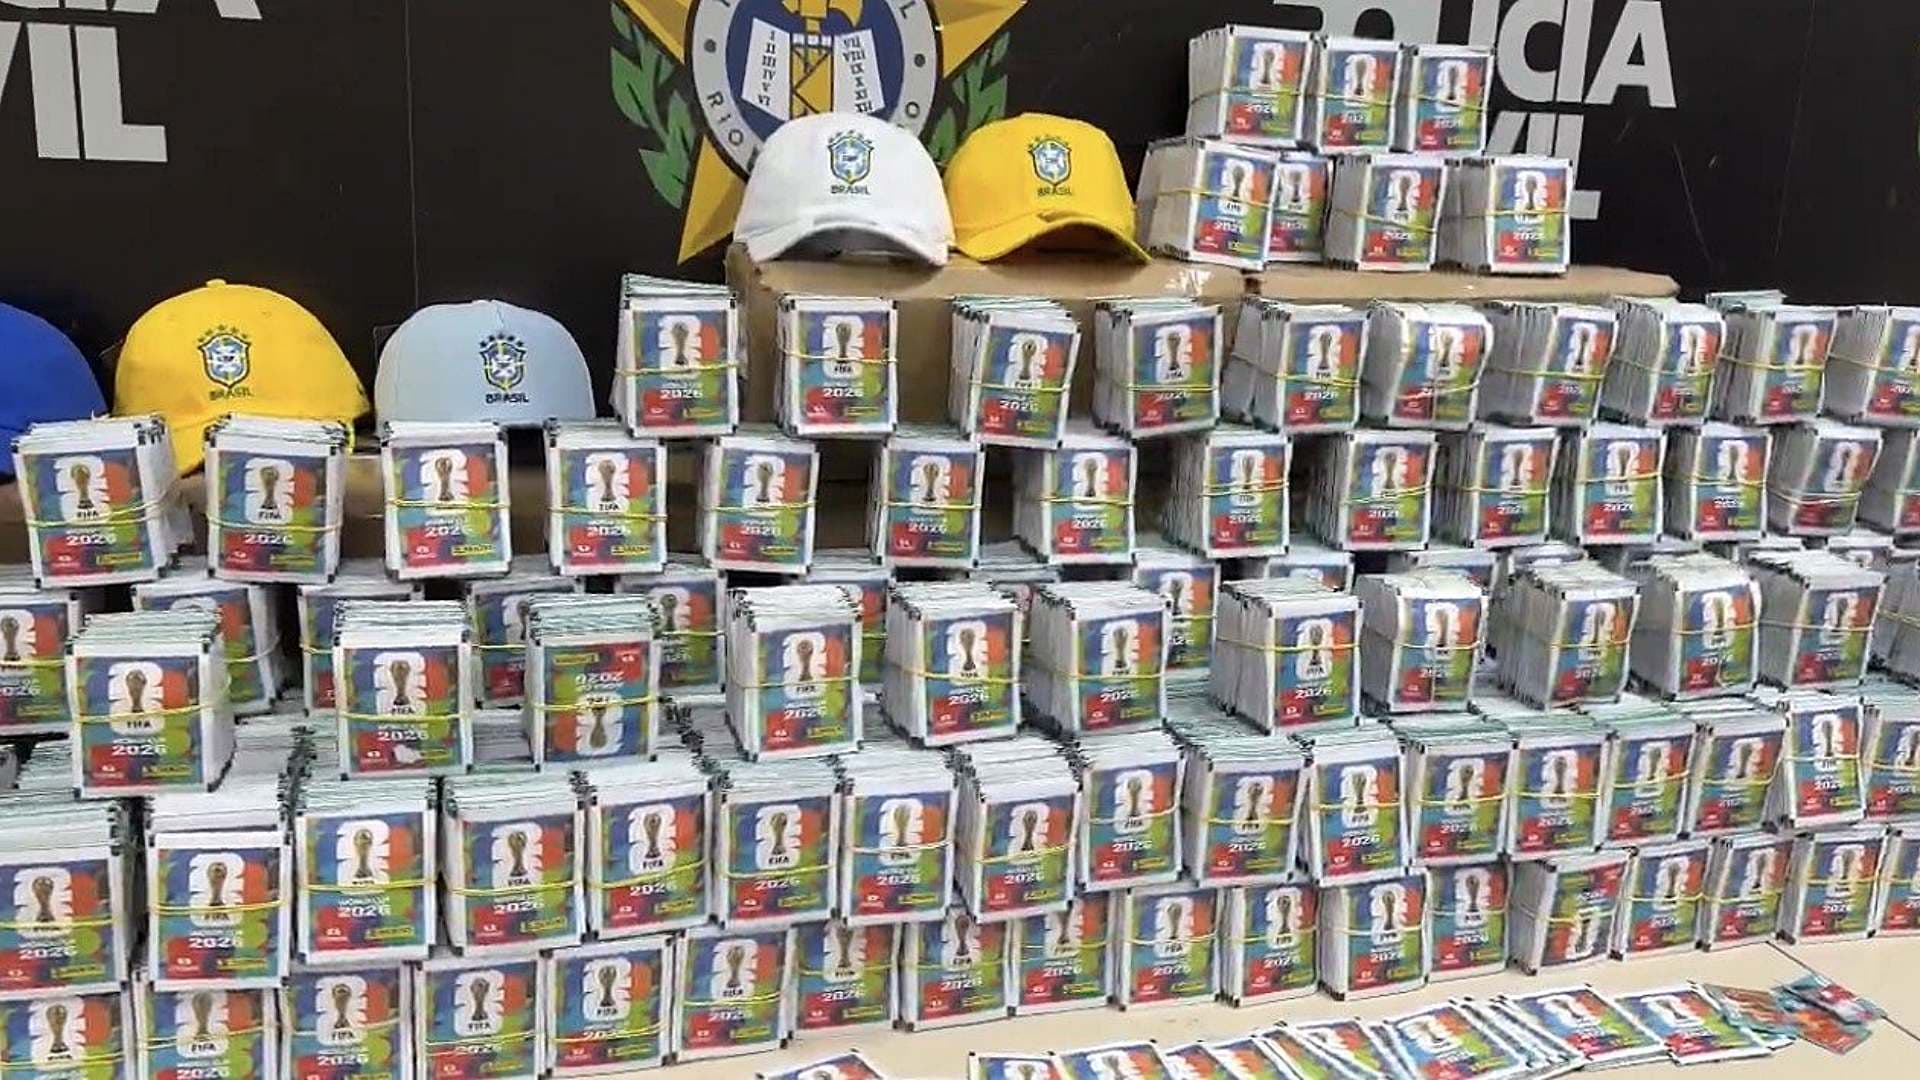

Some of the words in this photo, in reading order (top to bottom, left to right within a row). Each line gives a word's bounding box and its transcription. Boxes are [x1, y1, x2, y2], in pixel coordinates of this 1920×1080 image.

[830, 185, 871, 195] BRASIL
[660, 388, 704, 400] 2026
[823, 387, 864, 398] 2026
[484, 393, 529, 404] BRASIL
[76, 511, 98, 519] FIFA
[258, 511, 282, 519] FIFA
[244, 533, 293, 545] 2026
[0, 686, 41, 697] 026
[126, 720, 152, 729] FIFA
[377, 730, 430, 742] 2026
[112, 744, 168, 756] 2026
[1341, 834, 1380, 849] 2026
[643, 860, 664, 870] FIFA
[768, 855, 790, 865] FIFA
[508, 877, 531, 888] FIFA
[338, 905, 391, 918] 2026
[492, 901, 544, 915] 2026
[188, 936, 243, 949] 2026
[18, 947, 78, 961] 2026
[596, 1007, 618, 1017] FIFA
[468, 1021, 491, 1031] FIFA
[331, 1030, 354, 1041] FIFA
[191, 1042, 215, 1052] FIFA
[317, 1053, 369, 1066] 2026
